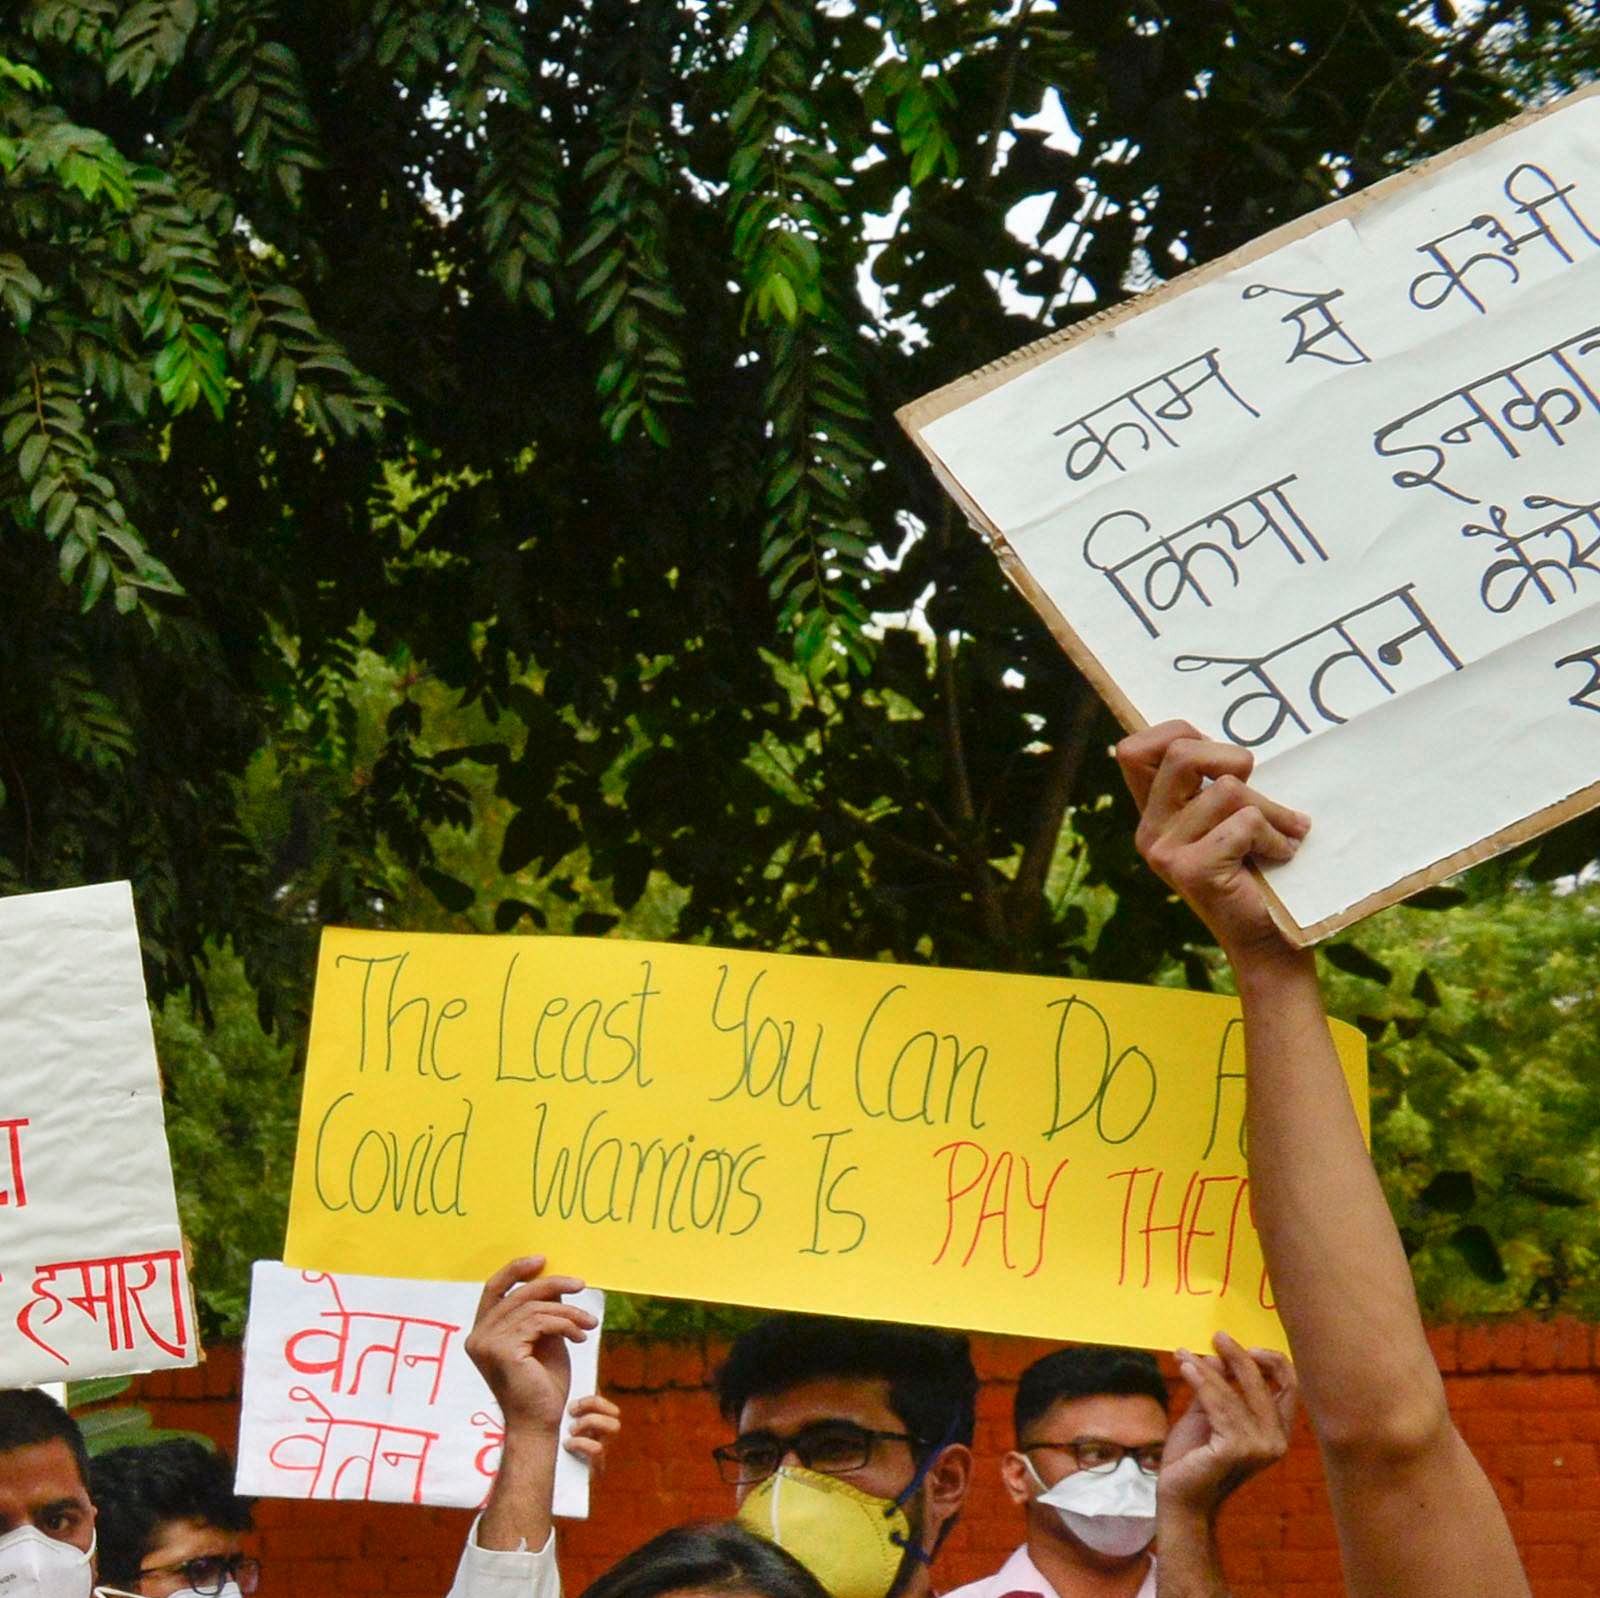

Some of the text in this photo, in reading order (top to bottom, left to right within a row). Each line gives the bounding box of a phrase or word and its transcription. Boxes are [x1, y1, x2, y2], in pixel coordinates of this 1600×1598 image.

[1054, 163, 1600, 480] काम से कभी
[1083, 474, 1328, 639] किया
[1174, 583, 1463, 747] वेतन
[335, 950, 468, 1081] The
[495, 951, 661, 1089] Least
[709, 963, 822, 1111] You
[854, 984, 988, 1130] Can
[1042, 993, 1157, 1145] Do
[314, 1091, 474, 1217] Covid
[532, 1101, 767, 1237] Warriors
[798, 1128, 868, 1256] Is
[931, 1140, 1070, 1279] PAY
[14, 1249, 190, 1366] हमारा
[283, 1269, 461, 1406] वेतन
[267, 1385, 440, 1505] वेतन
